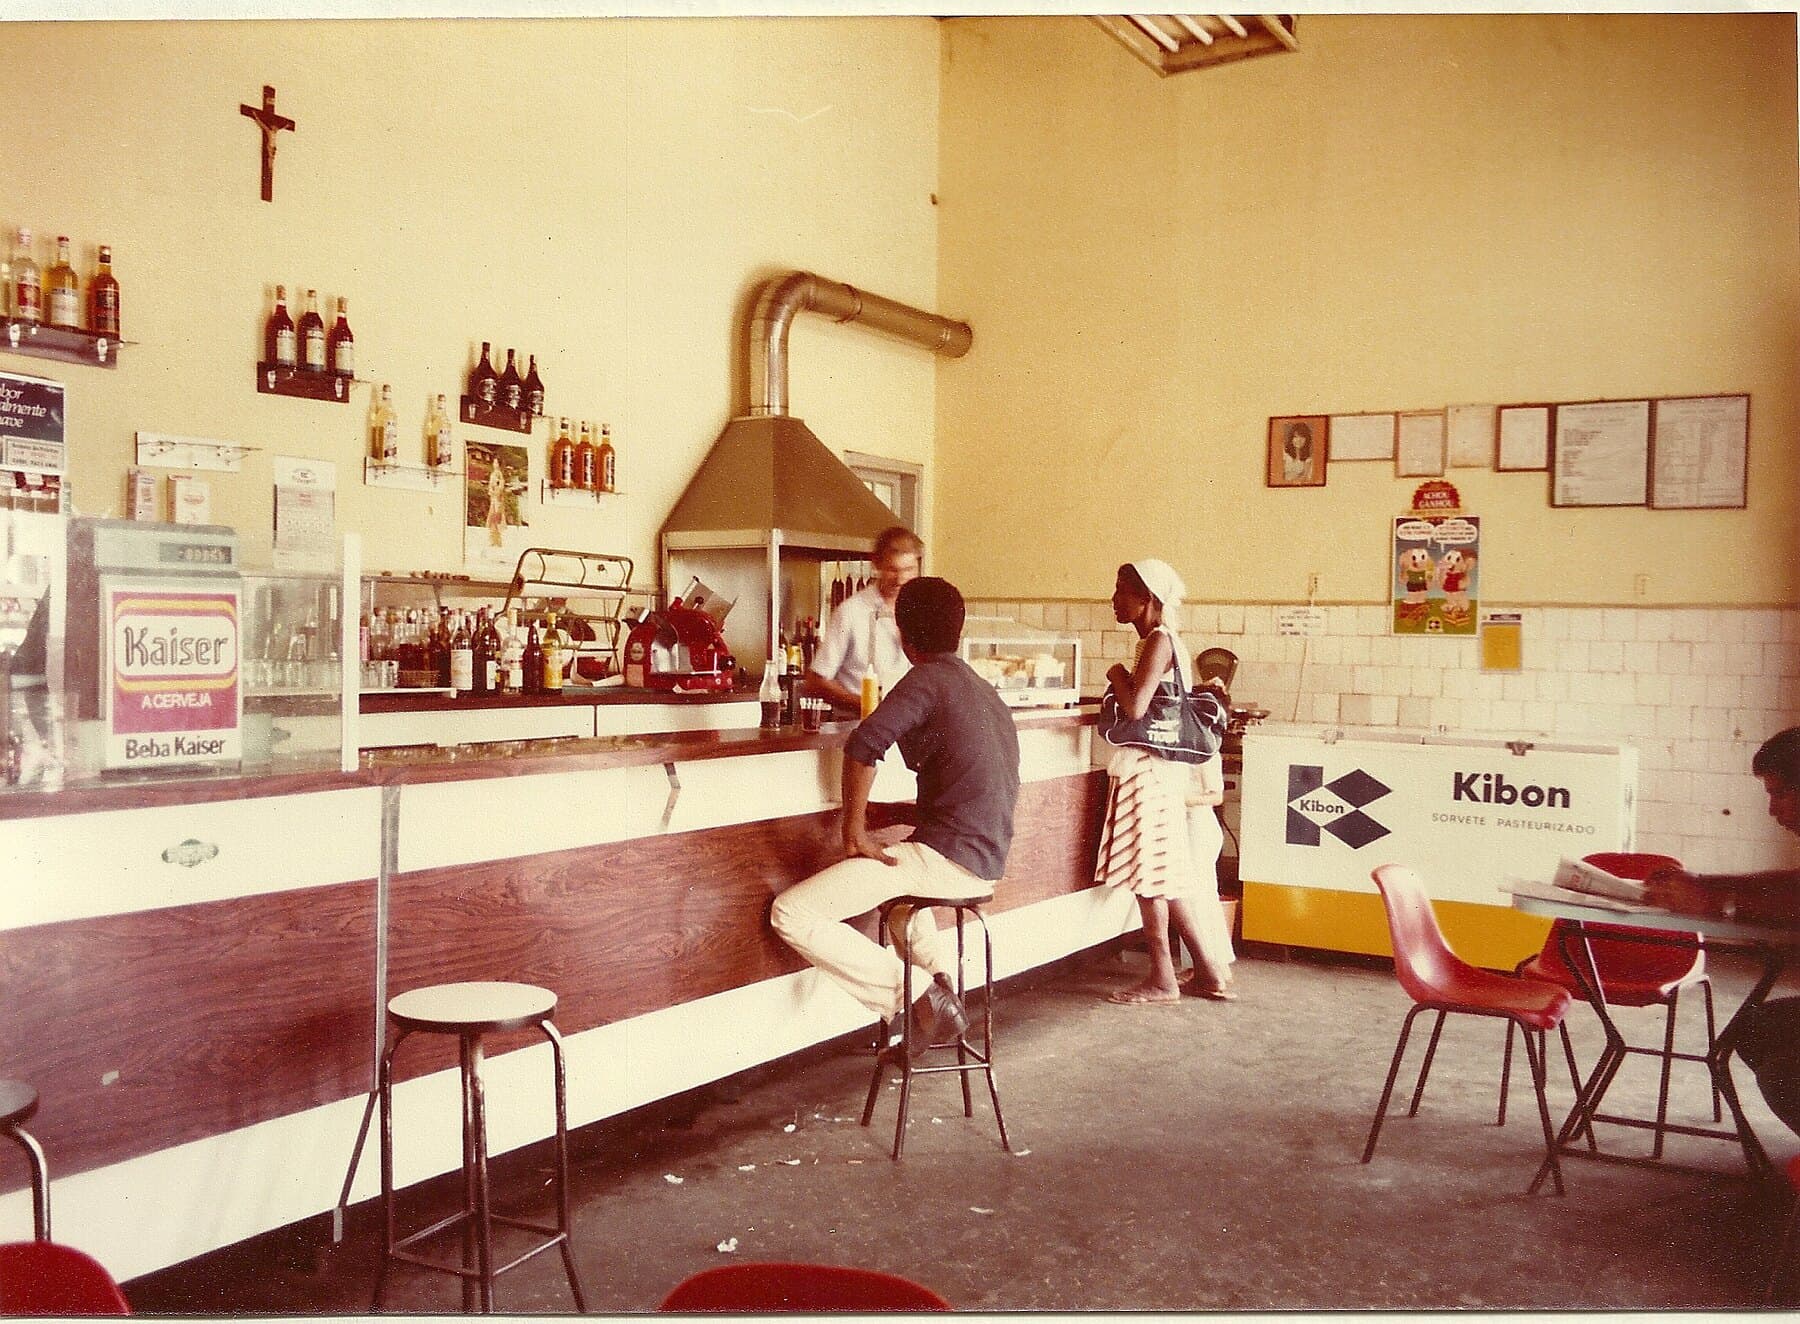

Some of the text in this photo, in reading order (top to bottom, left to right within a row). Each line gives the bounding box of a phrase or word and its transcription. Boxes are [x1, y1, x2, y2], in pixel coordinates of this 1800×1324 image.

[0, 383, 24, 399] bor
[124, 626, 228, 666] Kaiser
[142, 693, 212, 709] A CERVEJA
[125, 736, 226, 759] Beba Kaiser
[1453, 771, 1571, 809] Kibon
[1300, 799, 1345, 814] Kibon
[1431, 813, 1596, 835] SORVETE PASTEURIZADO
